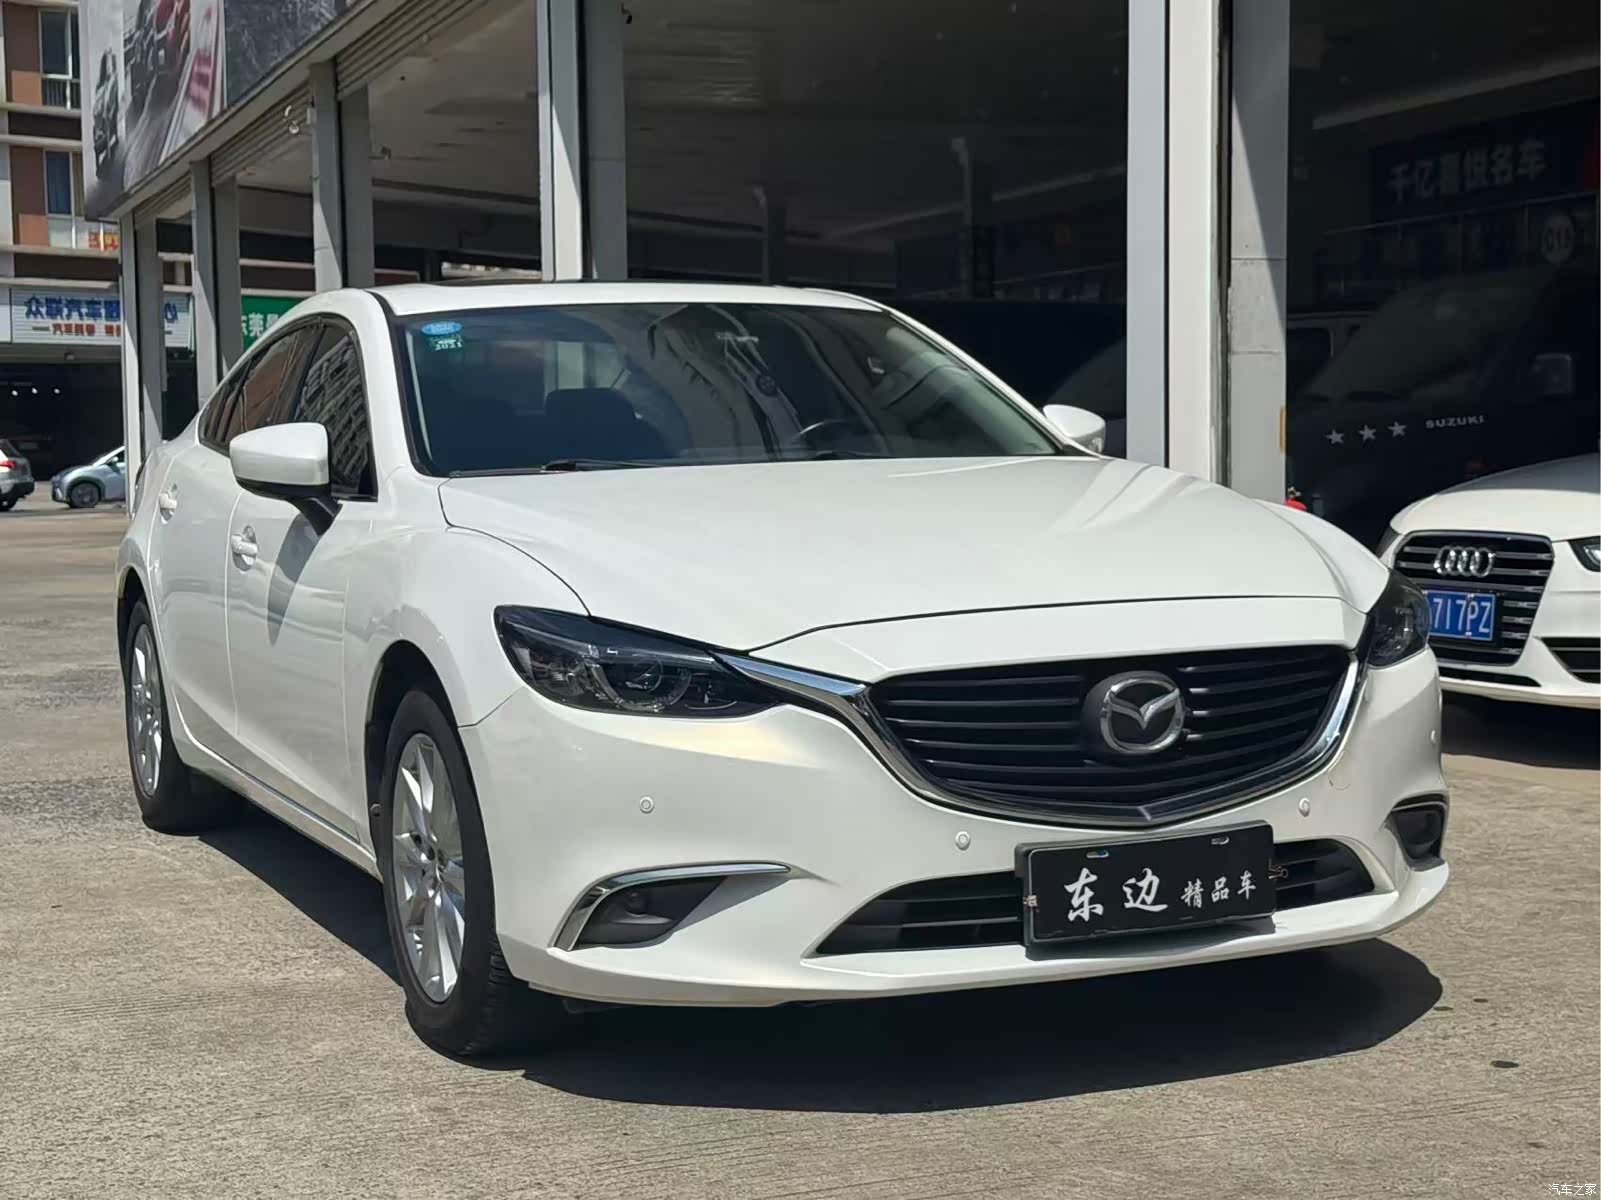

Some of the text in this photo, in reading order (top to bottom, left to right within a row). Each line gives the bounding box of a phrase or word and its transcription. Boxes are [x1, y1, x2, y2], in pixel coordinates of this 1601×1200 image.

[1425, 415, 1484, 429] SUZUKI
[1064, 867, 1256, 922] 东边 精品车
